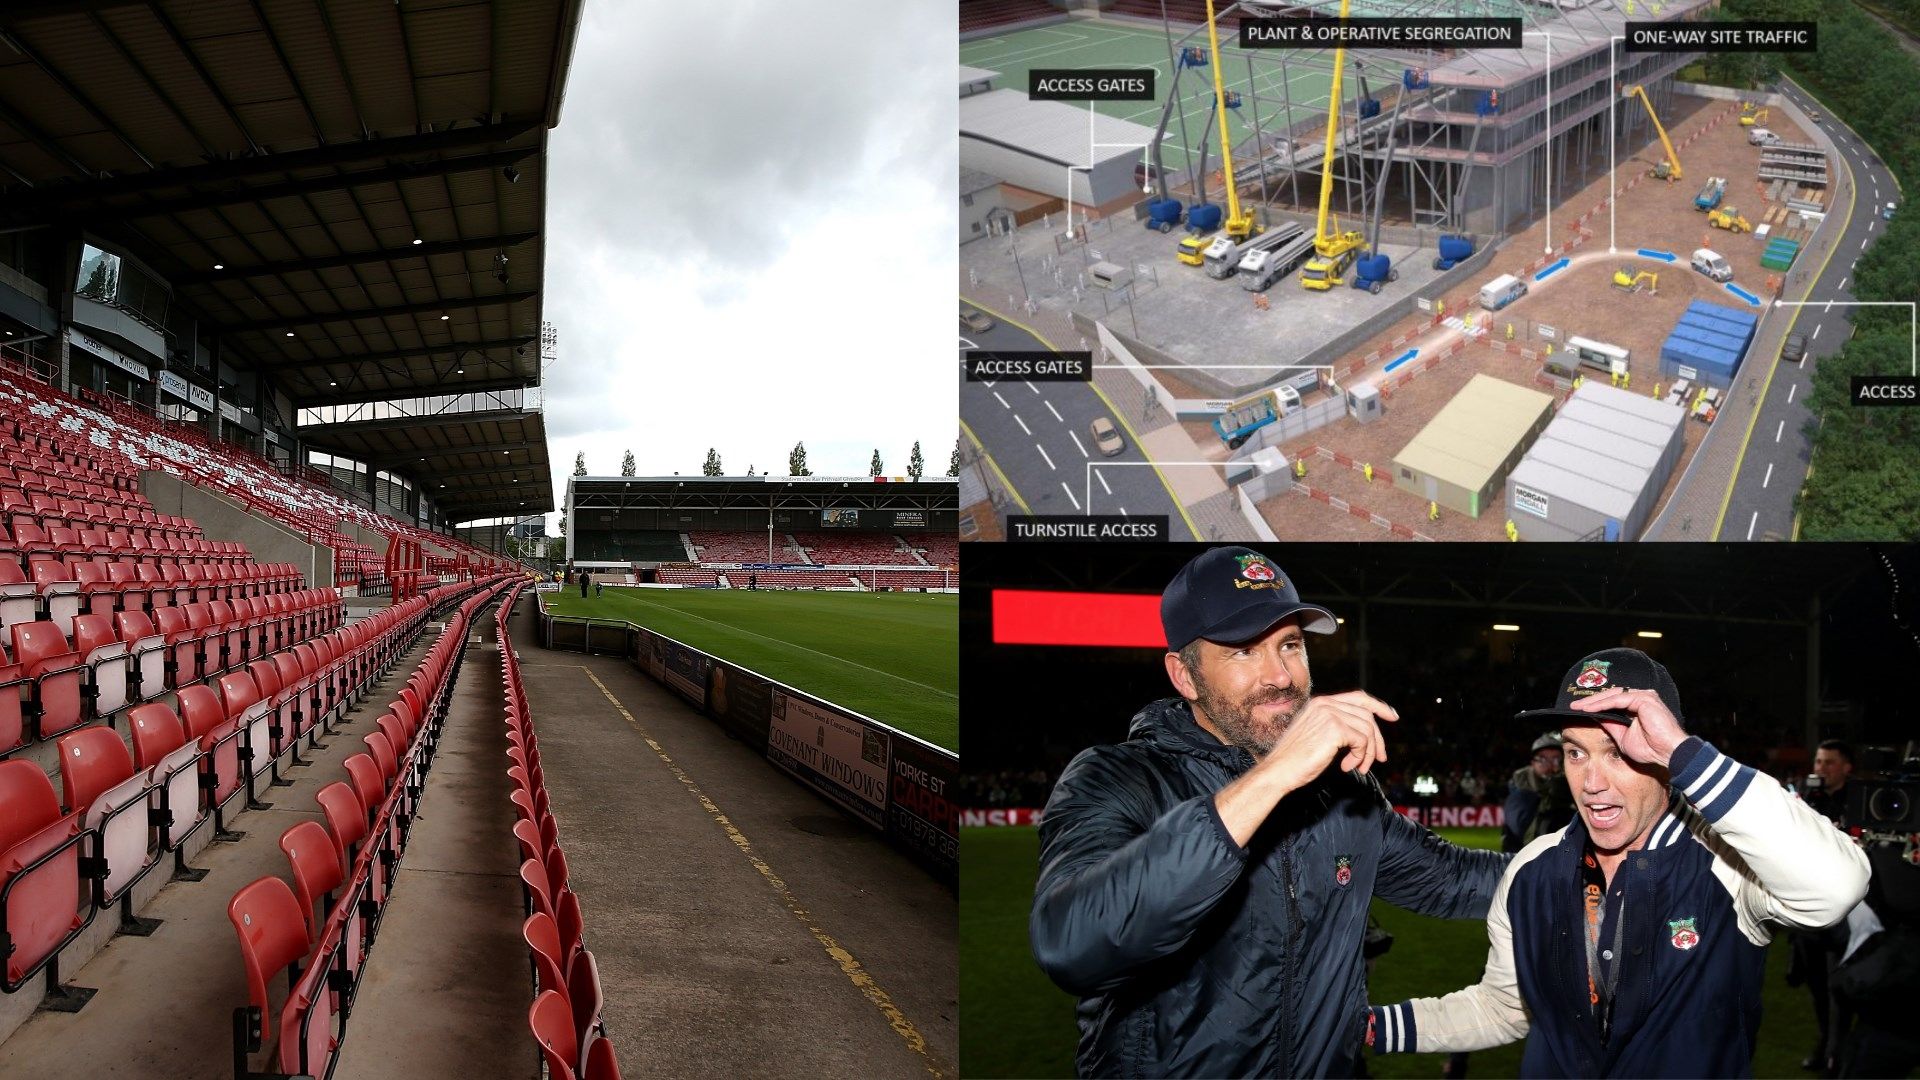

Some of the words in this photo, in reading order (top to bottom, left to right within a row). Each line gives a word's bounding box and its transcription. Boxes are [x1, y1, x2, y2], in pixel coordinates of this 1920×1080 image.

[125, 359, 145, 375] NOVUS
[1516, 488, 1547, 505] MORGAN
[770, 726, 818, 765] COVENANT
[822, 752, 885, 803] WINDOWS
[894, 757, 928, 788] YORKE
[930, 776, 945, 796] ST
[959, 809, 1017, 826] NS!
